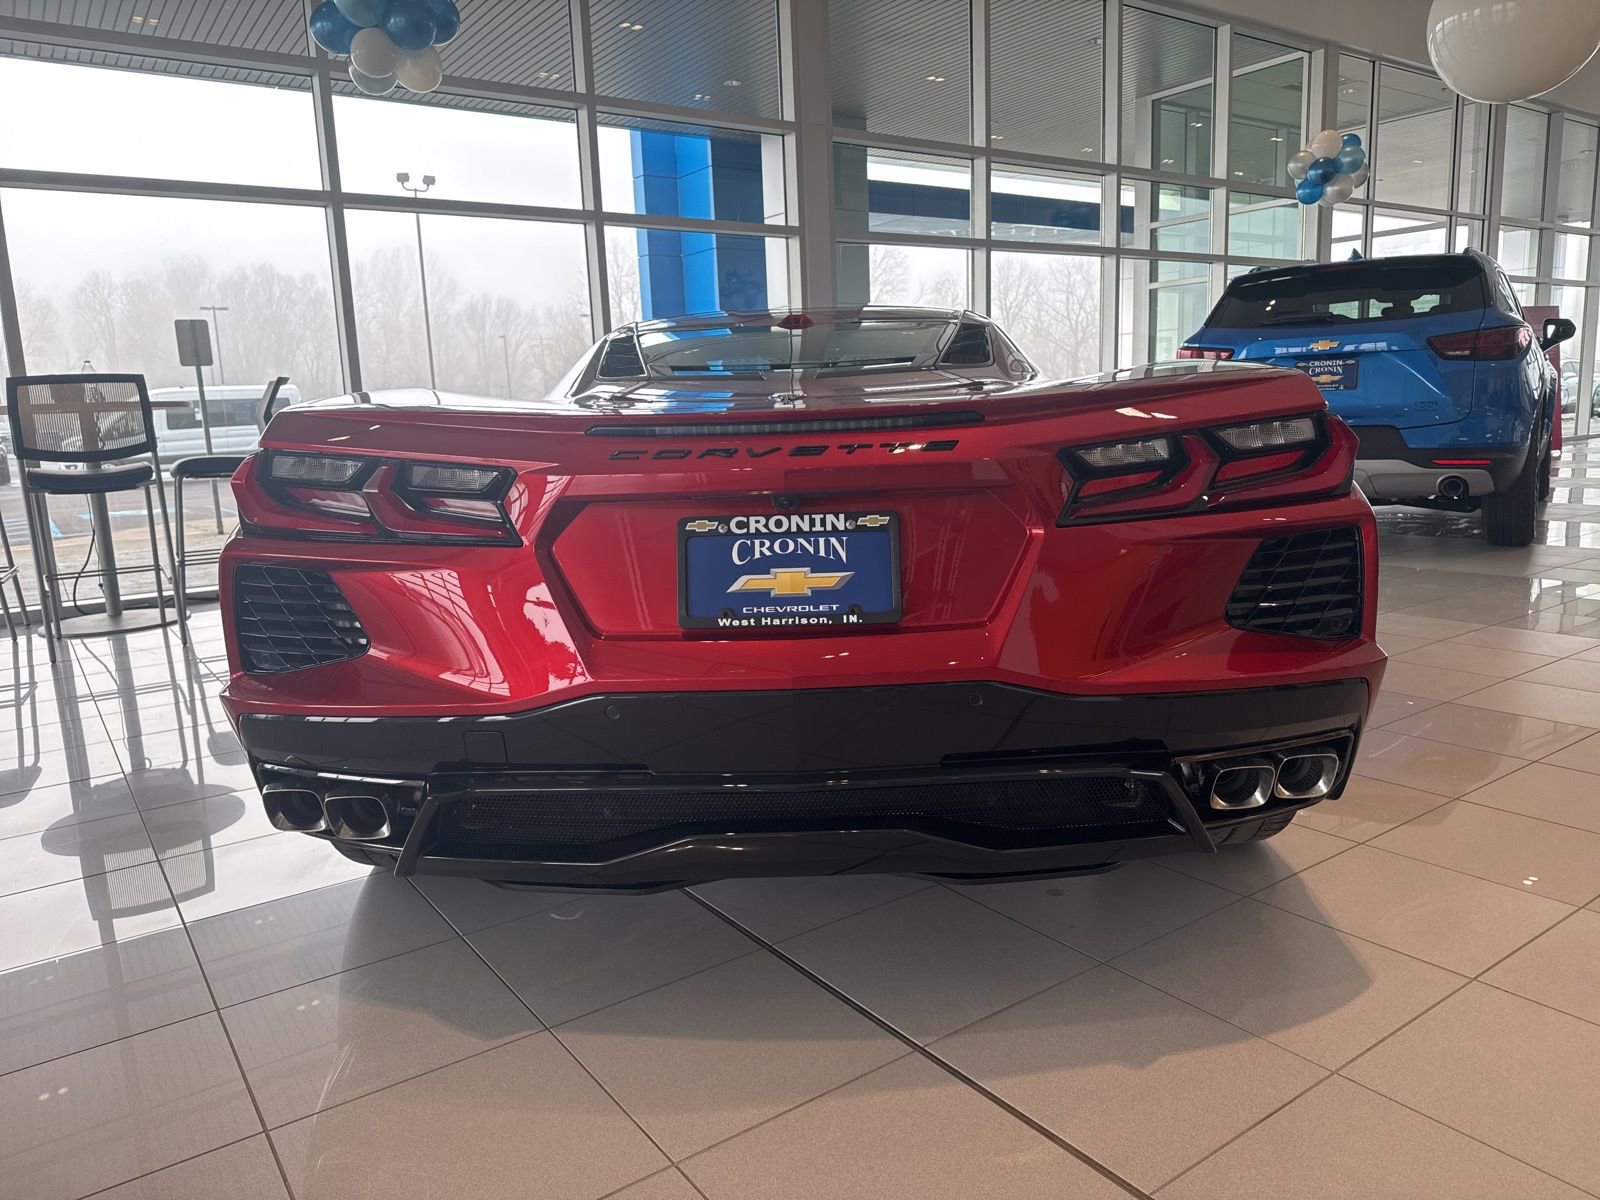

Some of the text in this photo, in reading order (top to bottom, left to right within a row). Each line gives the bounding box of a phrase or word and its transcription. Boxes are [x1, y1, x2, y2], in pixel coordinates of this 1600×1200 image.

[1309, 366, 1343, 375] CRONIN
[608, 440, 959, 460] CORVETTE
[729, 514, 845, 534] CRONIN
[731, 537, 848, 566] CRONIN
[743, 605, 839, 614] CHEVROLET
[718, 611, 863, 627] West Harrison, IN.
